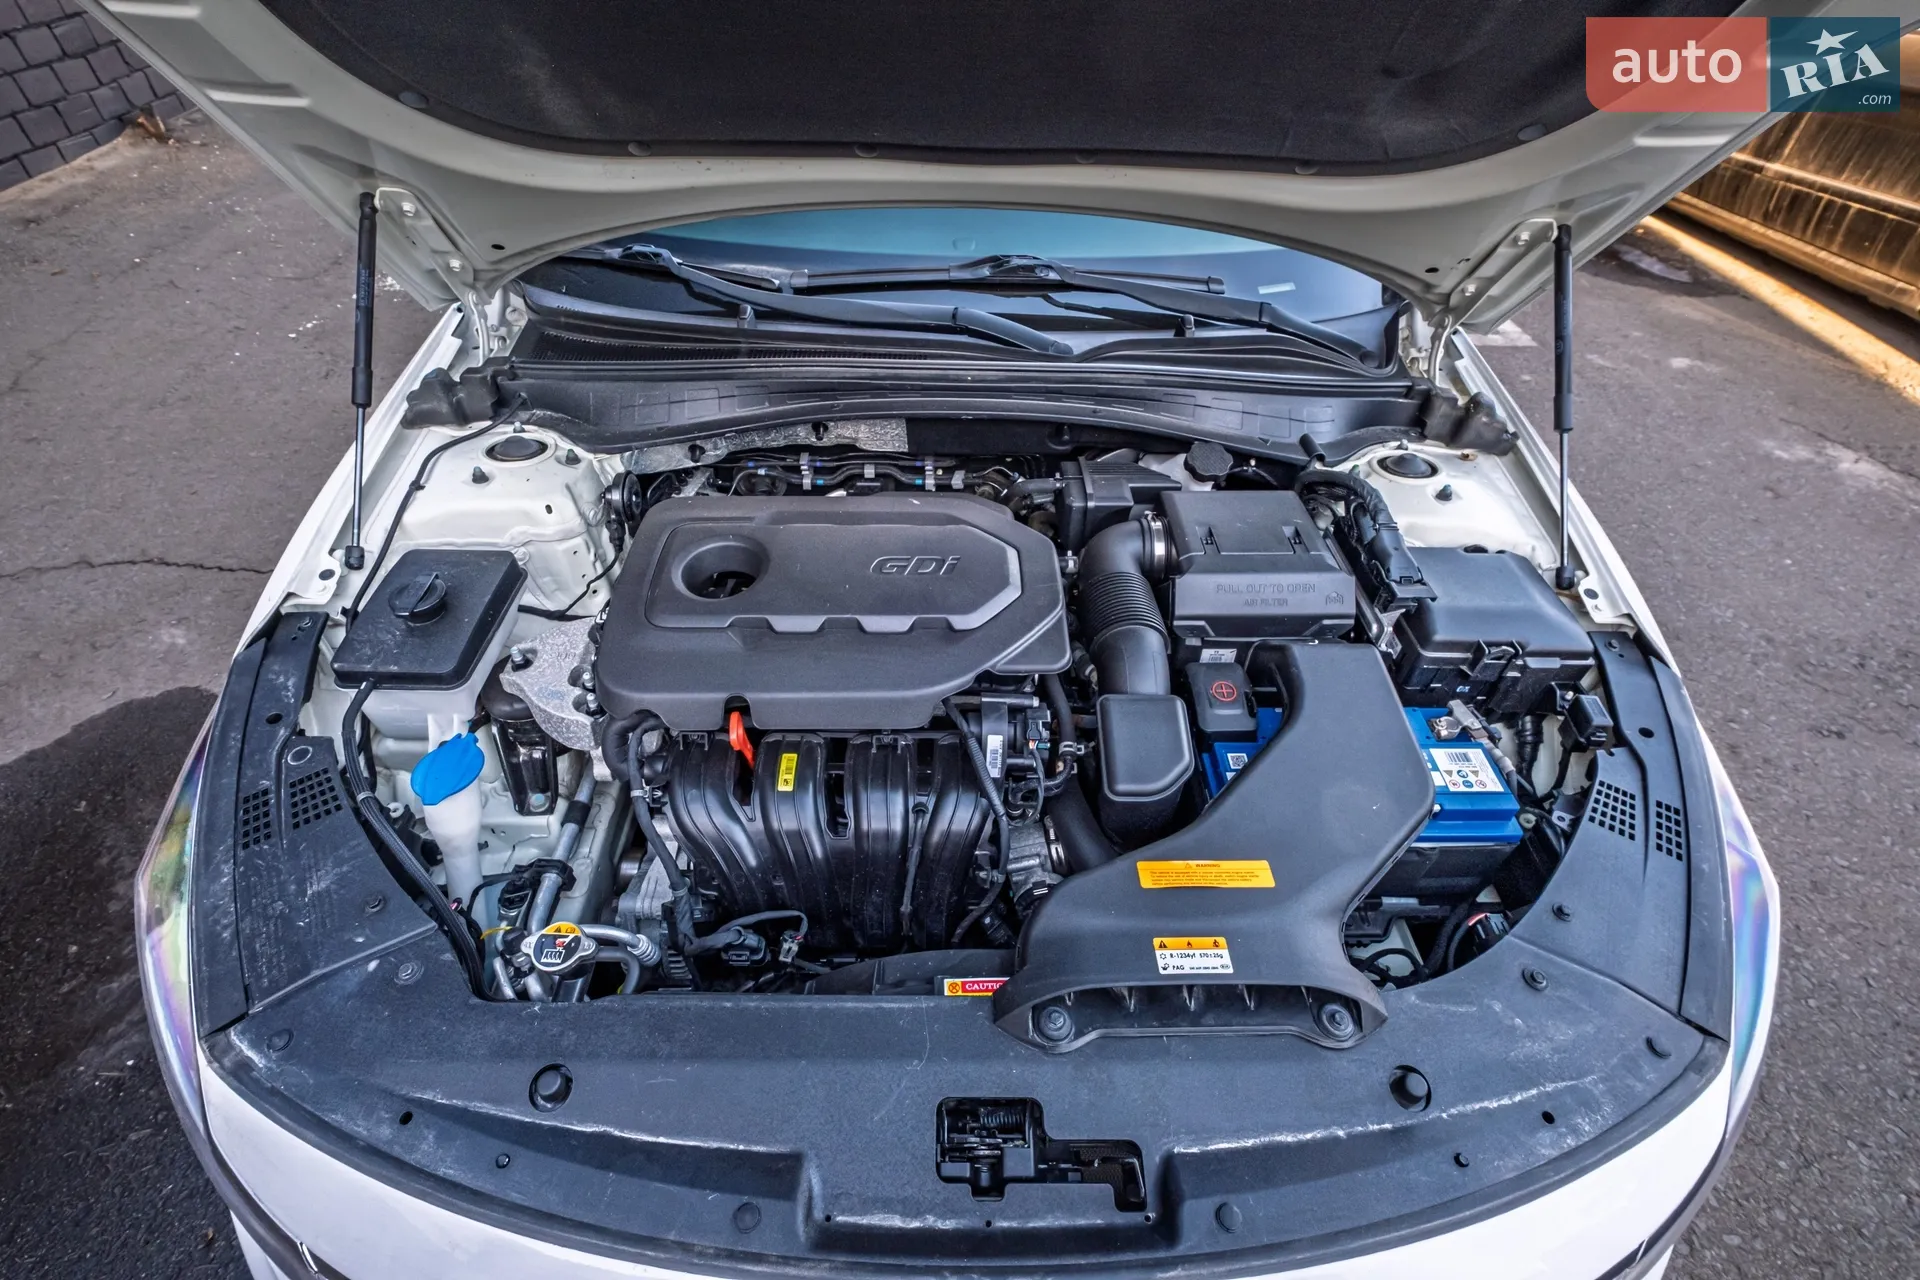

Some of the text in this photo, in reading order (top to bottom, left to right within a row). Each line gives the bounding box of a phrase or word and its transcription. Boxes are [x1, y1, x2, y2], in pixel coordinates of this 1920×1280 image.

[869, 555, 961, 576] GDi
[1216, 583, 1316, 594] PULL OUT TO OPEN
[1244, 598, 1288, 607] AIR FILTER
